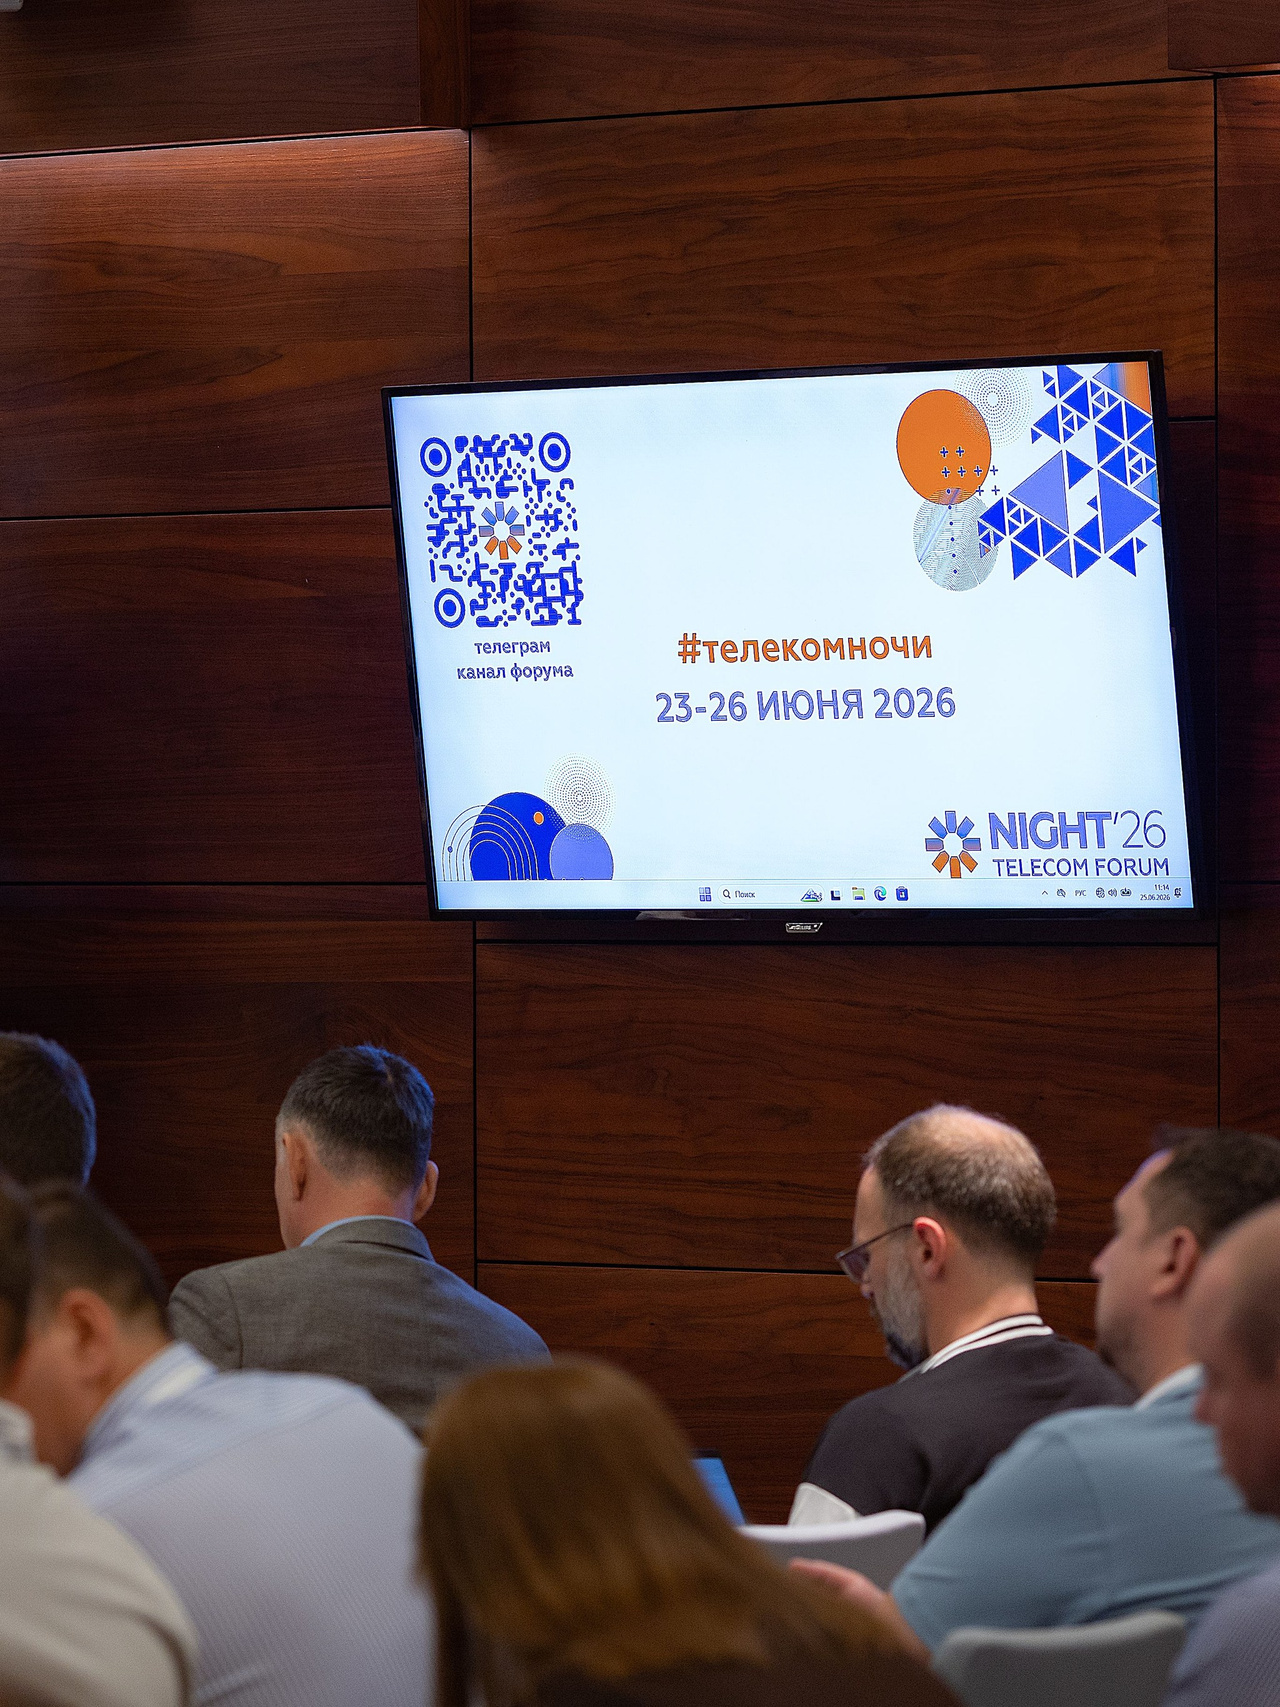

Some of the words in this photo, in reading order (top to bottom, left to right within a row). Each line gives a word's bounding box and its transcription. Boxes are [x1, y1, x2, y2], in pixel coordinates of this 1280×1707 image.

[474, 641, 551, 657] телеграм
[677, 632, 933, 663] #телекомночи
[457, 667, 506, 679] канал
[510, 662, 574, 682] форума
[656, 691, 748, 723] 23-26
[757, 688, 864, 720] ИЮНЯ
[873, 687, 956, 718] 2026
[992, 858, 1089, 877] TELECOM
[1095, 857, 1170, 877] FORUM
[734, 889, 756, 899] Поиск
[1074, 889, 1087, 897] РУС
